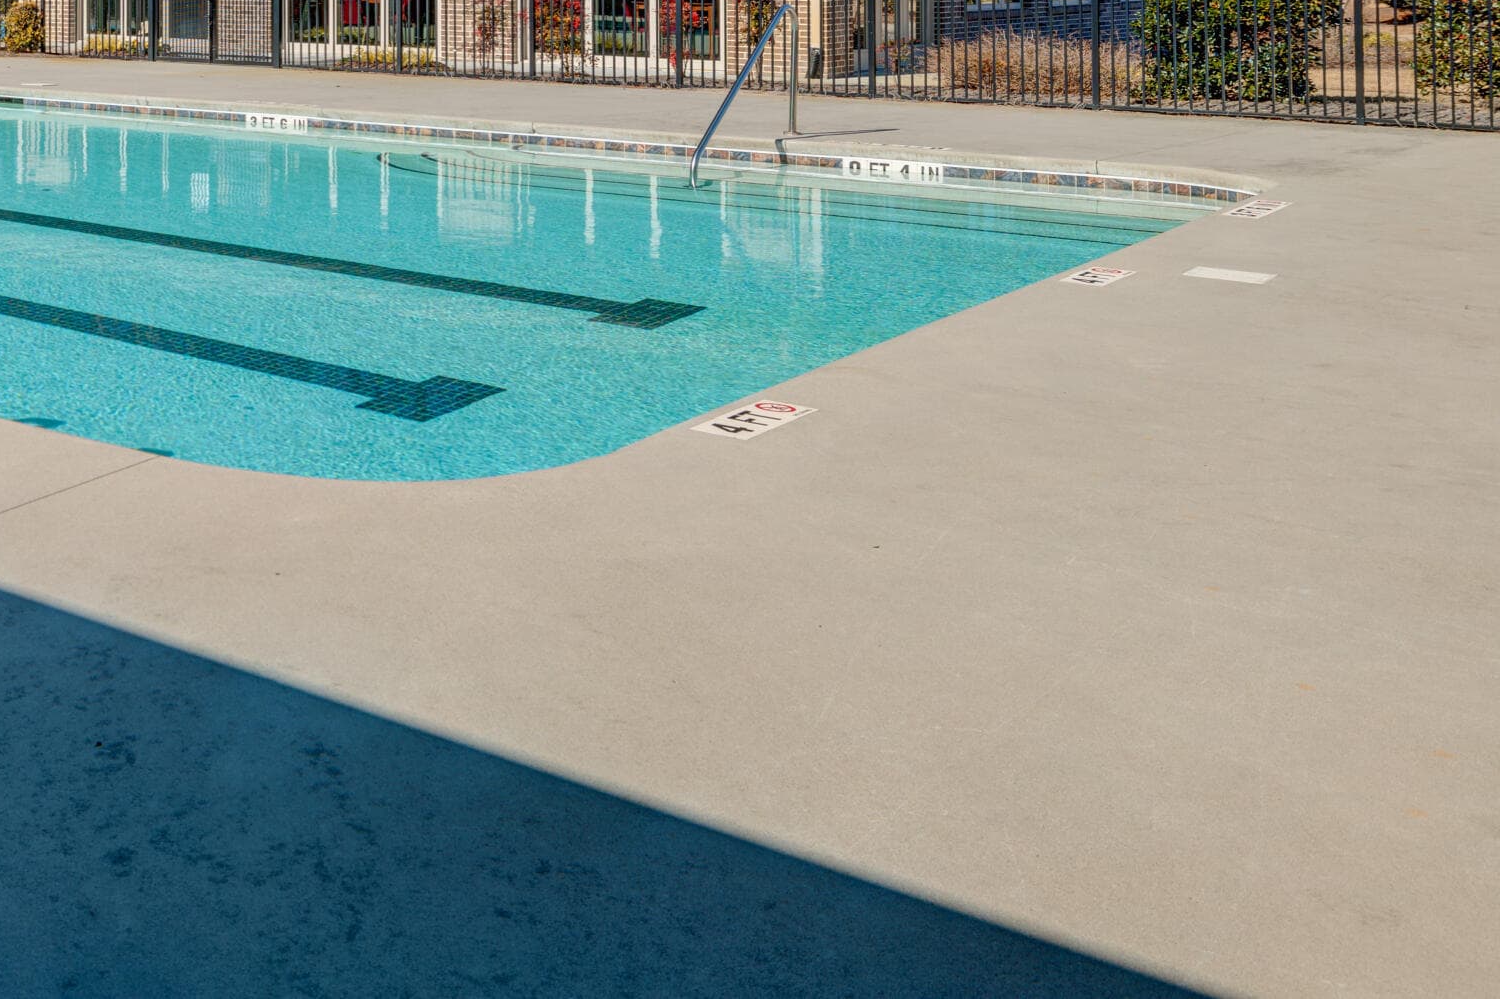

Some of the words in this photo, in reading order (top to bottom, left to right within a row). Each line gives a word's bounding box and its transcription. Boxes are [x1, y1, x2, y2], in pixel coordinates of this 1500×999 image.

[262, 116, 275, 129] FT
[869, 162, 890, 178] FT
[900, 164, 910, 180] 4
[921, 165, 940, 182] IN
[726, 410, 782, 427] FT
[711, 422, 755, 434] 4
